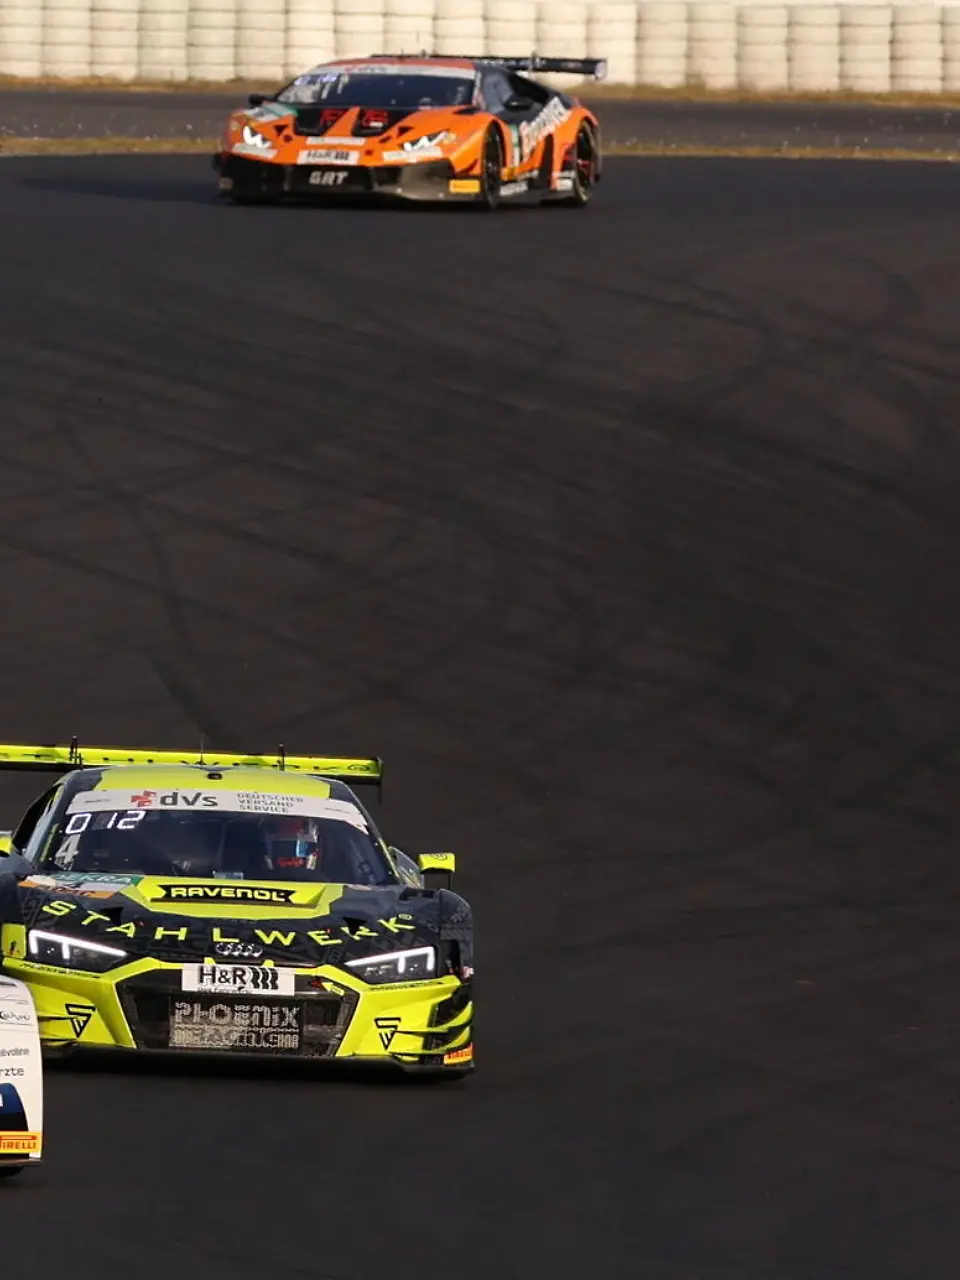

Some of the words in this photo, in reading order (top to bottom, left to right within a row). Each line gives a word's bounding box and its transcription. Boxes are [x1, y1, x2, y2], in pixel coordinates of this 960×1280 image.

[159, 790, 218, 808] dvs
[170, 886, 286, 902] RAVENOL
[198, 965, 247, 985] H&R
